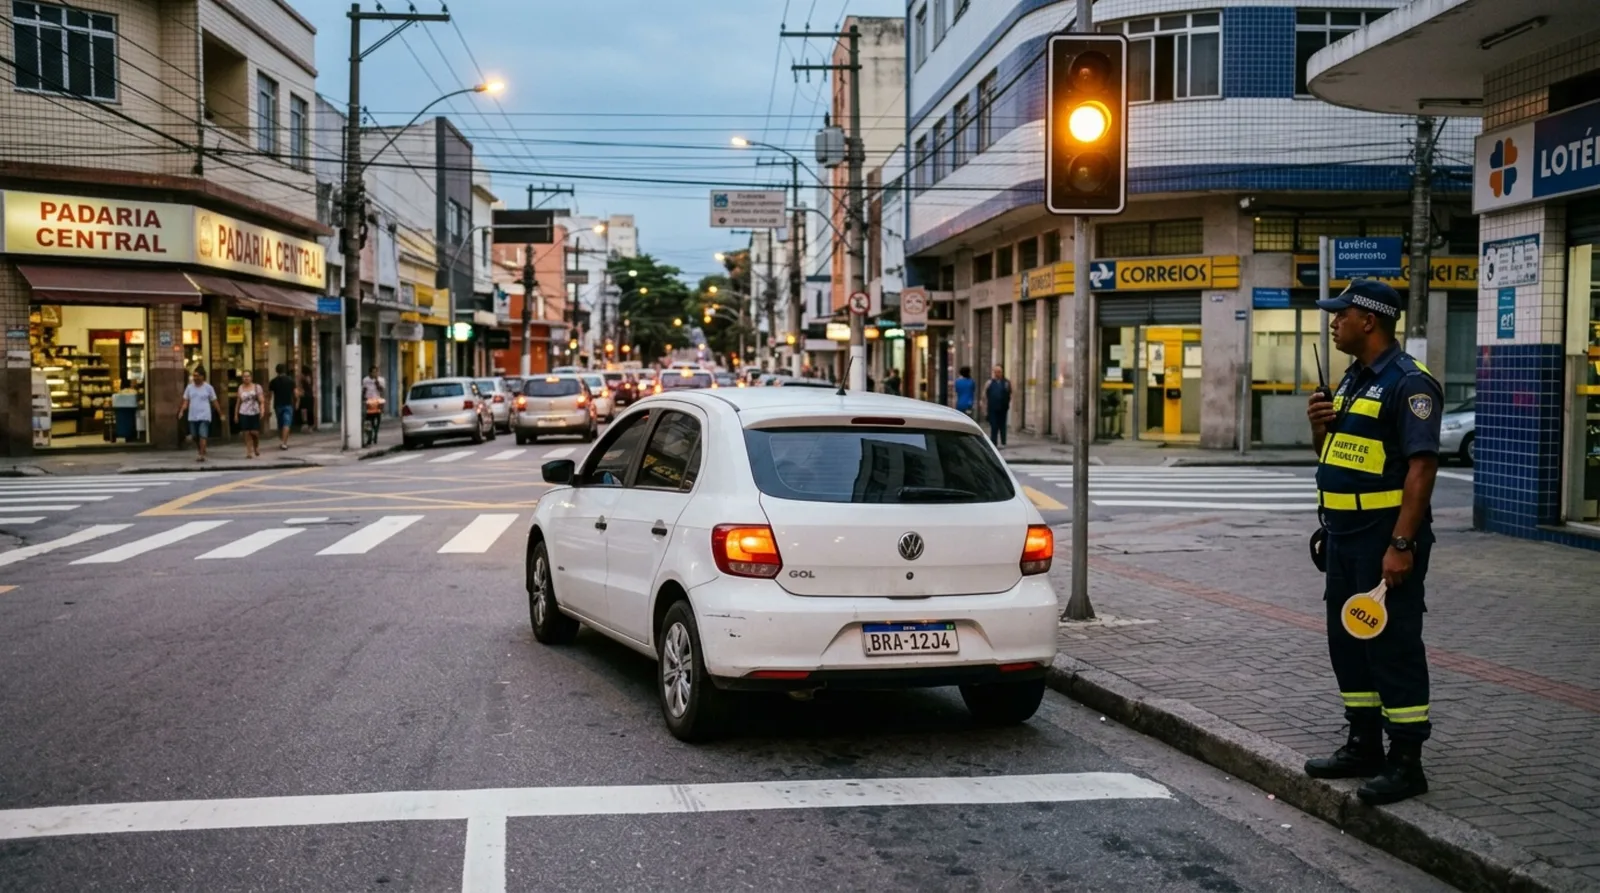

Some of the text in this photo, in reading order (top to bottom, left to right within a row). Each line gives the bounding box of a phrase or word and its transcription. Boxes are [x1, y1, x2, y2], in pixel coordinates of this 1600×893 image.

[40, 201, 162, 229] PADARIA
[36, 228, 167, 253] CENTRAL
[218, 225, 322, 279] PADARIA CENTRAL
[1120, 263, 1206, 283] CORREIOS
[788, 570, 816, 578] GOL
